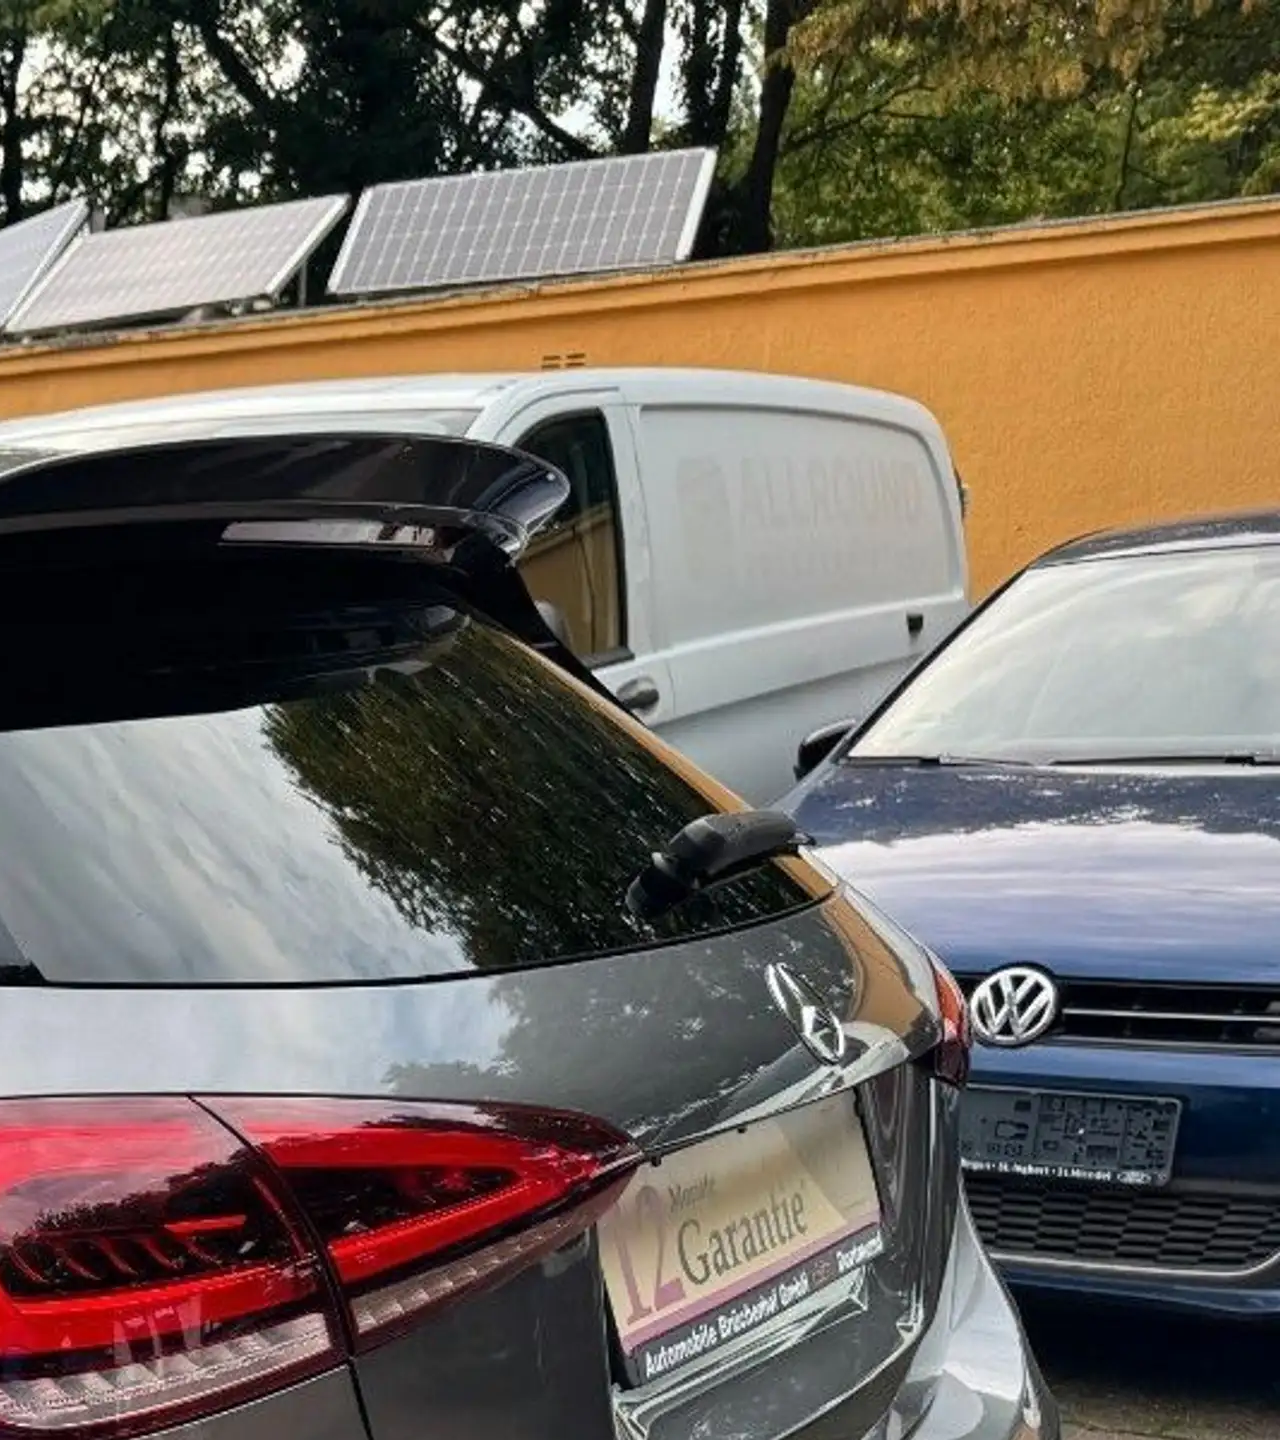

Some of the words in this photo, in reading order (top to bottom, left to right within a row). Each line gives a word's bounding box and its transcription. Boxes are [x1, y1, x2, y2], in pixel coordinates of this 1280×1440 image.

[610, 1184, 687, 1326] 12
[678, 1183, 810, 1286] Garantie
[645, 1325, 718, 1379] Automobile
